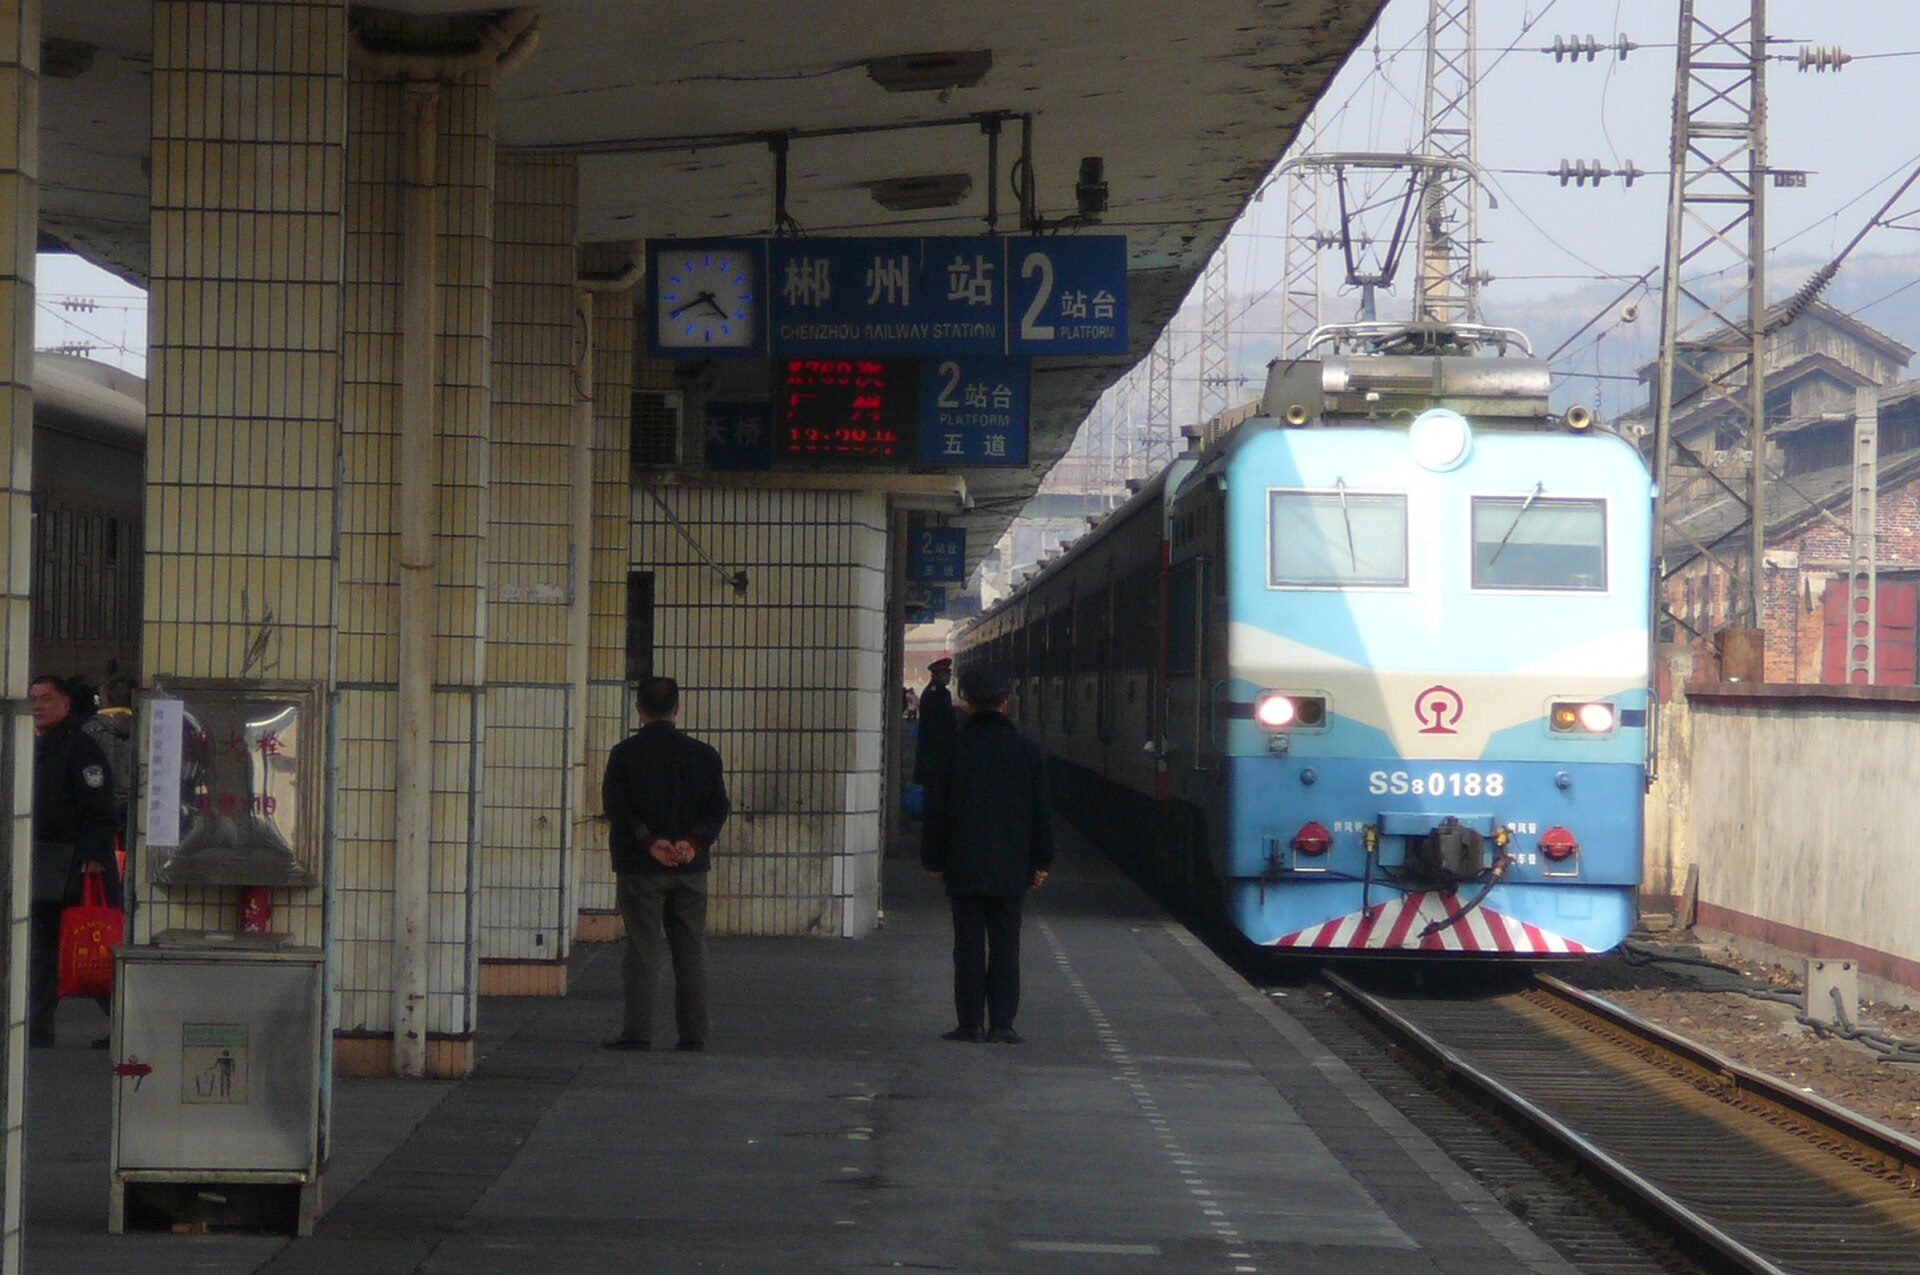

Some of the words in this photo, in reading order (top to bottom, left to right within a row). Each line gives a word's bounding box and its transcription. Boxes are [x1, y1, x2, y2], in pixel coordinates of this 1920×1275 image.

[783, 254, 994, 307] 郴州站
[1020, 251, 1055, 341] 2
[1061, 289, 1117, 320] 站台
[779, 323, 860, 341] CHENZHOU
[865, 324, 928, 340] RAILWAY
[932, 323, 997, 340] STATION
[1060, 324, 1116, 340] PLATFORM
[936, 360, 961, 409] 2
[964, 382, 1013, 410] 站台
[939, 413, 1011, 427] PLATFORM
[942, 432, 1007, 457] 五道
[922, 532, 933, 555] 2
